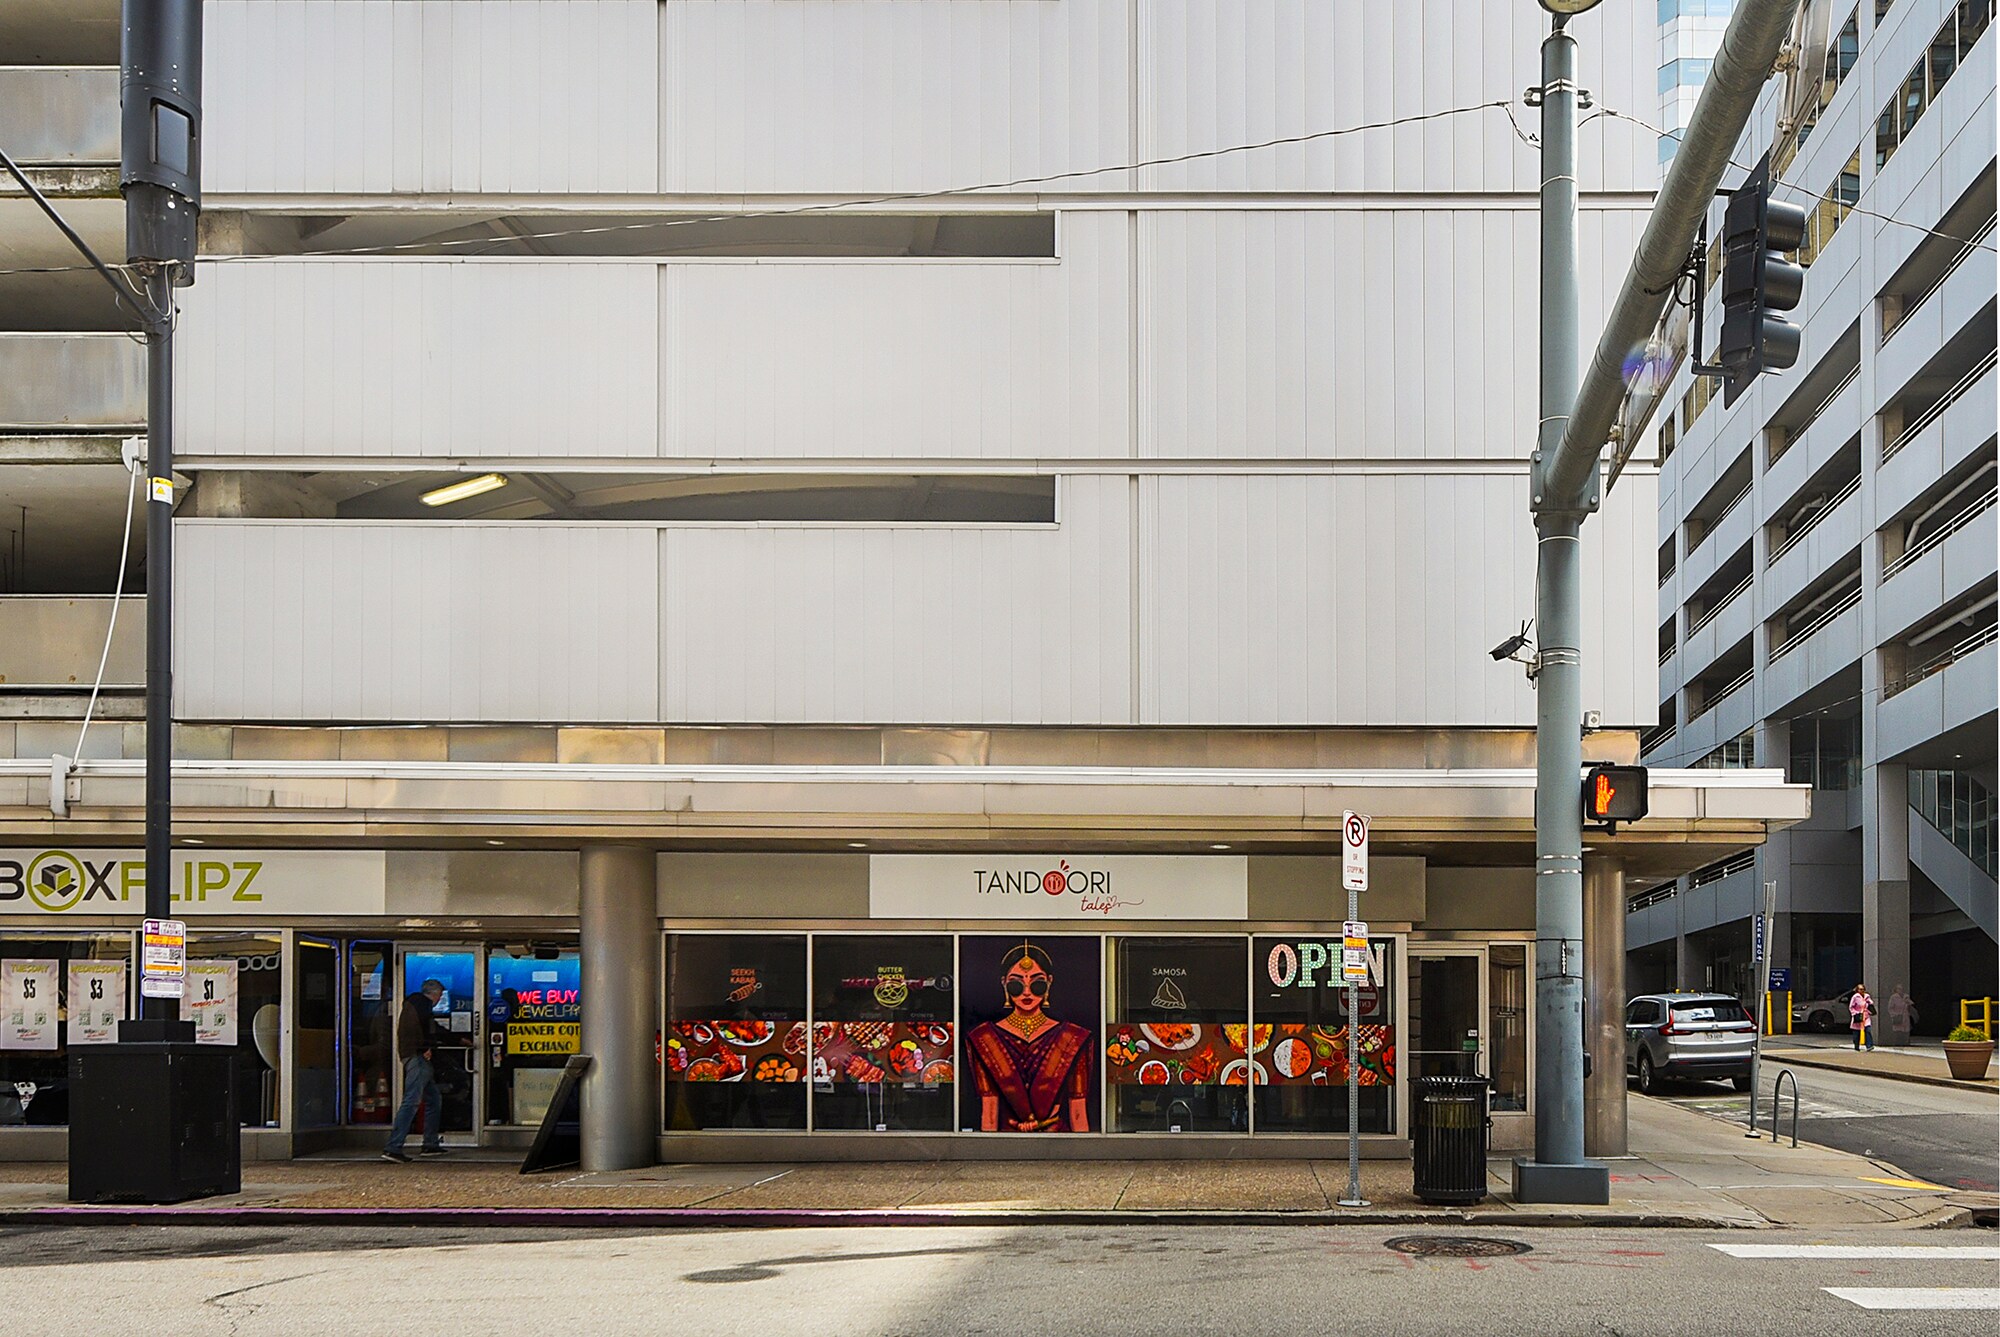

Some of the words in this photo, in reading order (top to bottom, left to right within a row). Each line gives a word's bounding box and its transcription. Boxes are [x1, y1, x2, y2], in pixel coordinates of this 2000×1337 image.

[0, 850, 263, 912] BOXFIPZ
[974, 869, 1111, 896] TANDOORI
[1081, 895, 1117, 914] tales
[11, 964, 49, 973] TUESDAY
[70, 965, 121, 974] WEDNESDAY
[731, 968, 755, 976] SEEKH
[1152, 968, 1187, 976] SAMOSA
[1268, 943, 1385, 987] OPEN
[877, 973, 905, 981] CHICKEN
[23, 976, 36, 999] $5
[90, 977, 103, 1000] $3
[203, 977, 214, 1001] $1
[517, 989, 542, 1004] WE
[547, 989, 578, 1004] BUY
[509, 1025, 554, 1036] BANNER
